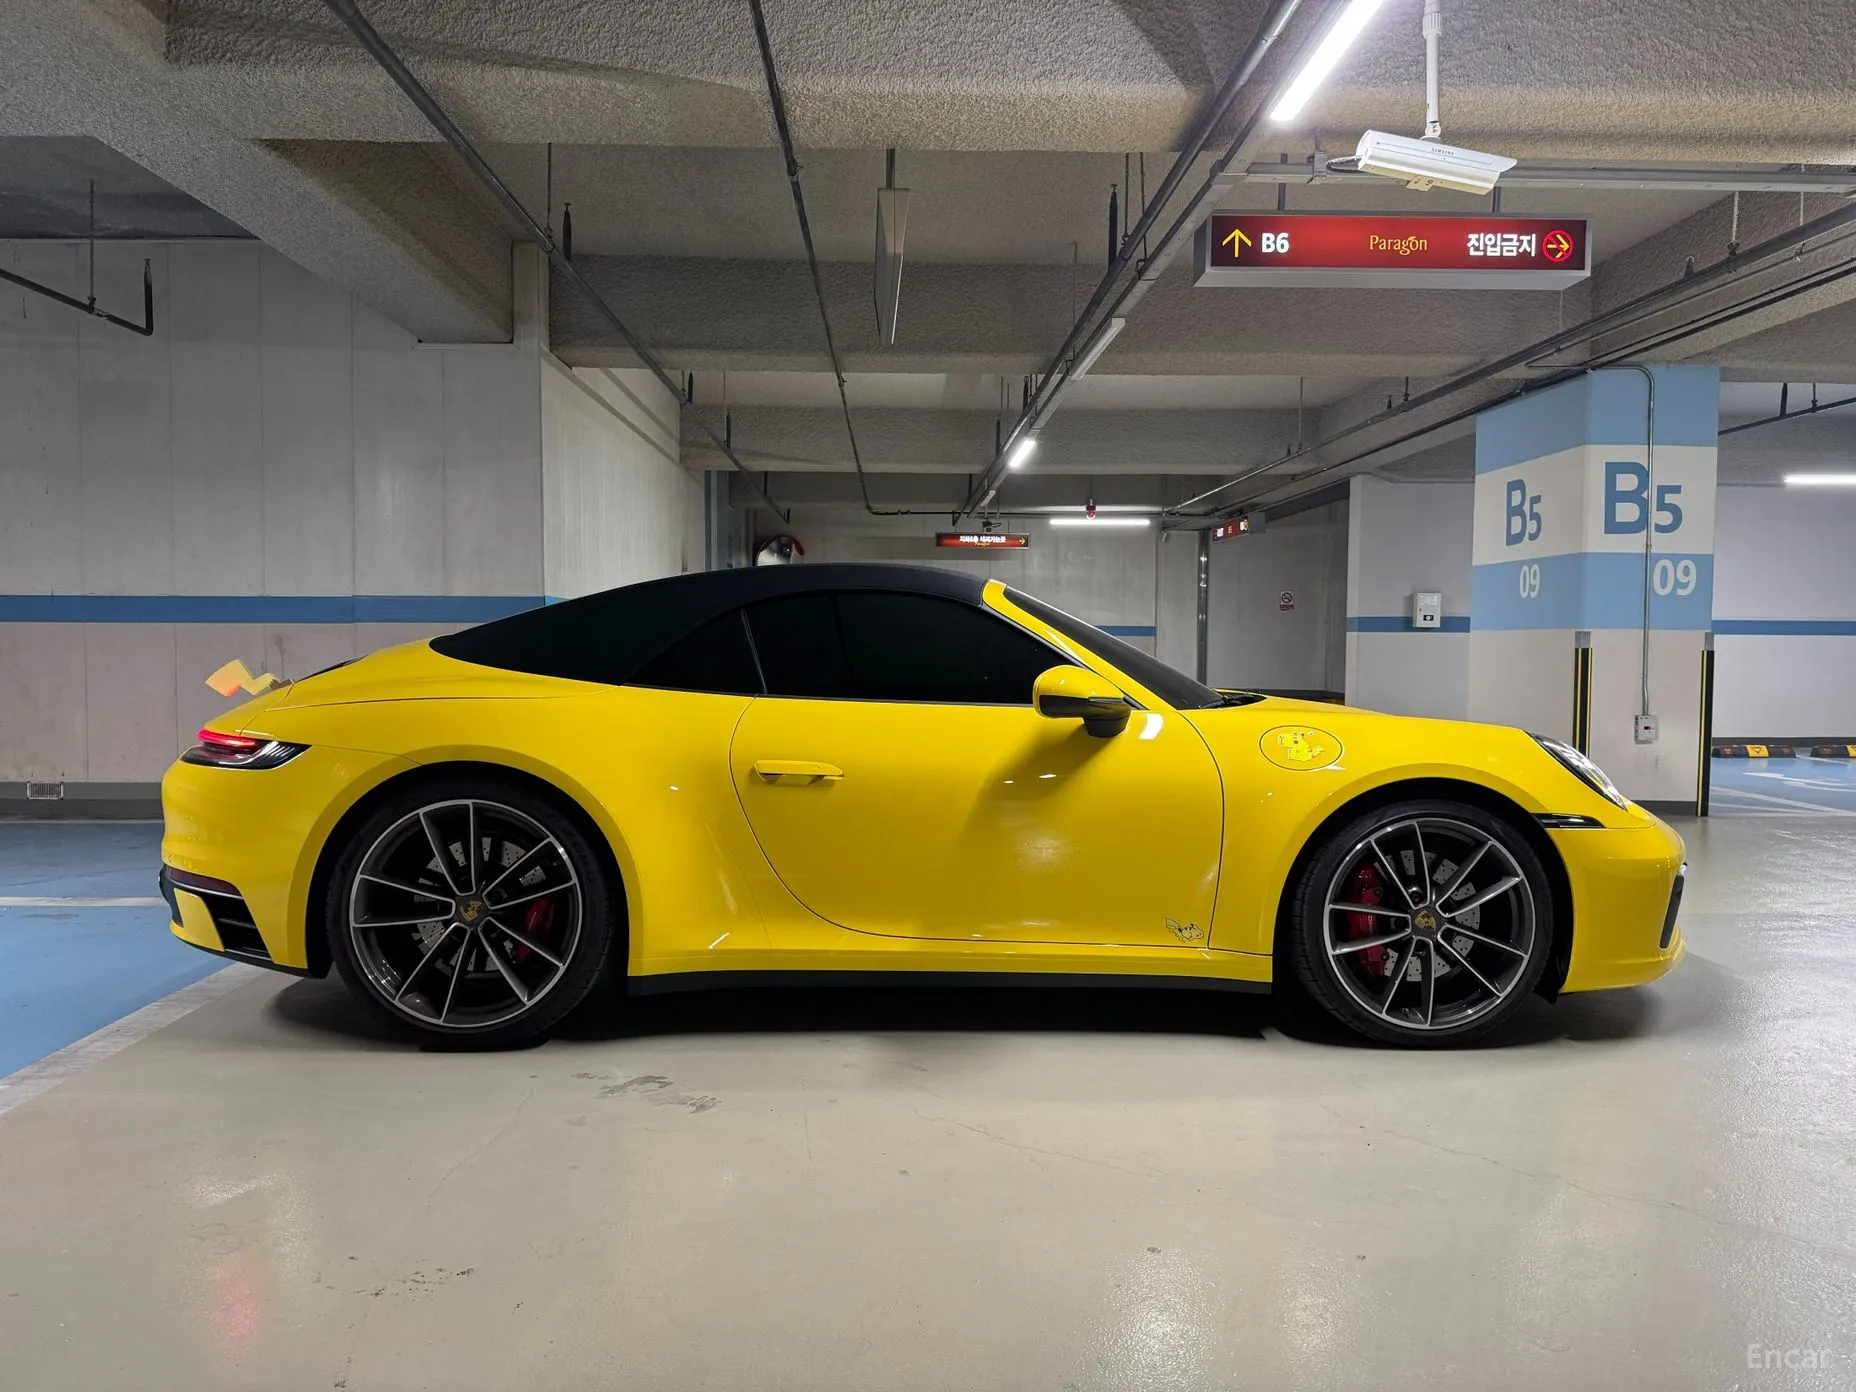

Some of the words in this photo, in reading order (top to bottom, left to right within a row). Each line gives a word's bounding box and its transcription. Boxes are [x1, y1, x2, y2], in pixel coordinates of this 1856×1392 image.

[1261, 232, 1290, 253] B6
[1369, 234, 1428, 256] Paragon
[1467, 232, 1537, 257] 진입금지
[1506, 478, 1542, 546] B5
[1604, 461, 1683, 534] B5
[1519, 563, 1541, 599] 09
[1652, 558, 1697, 596] 09
